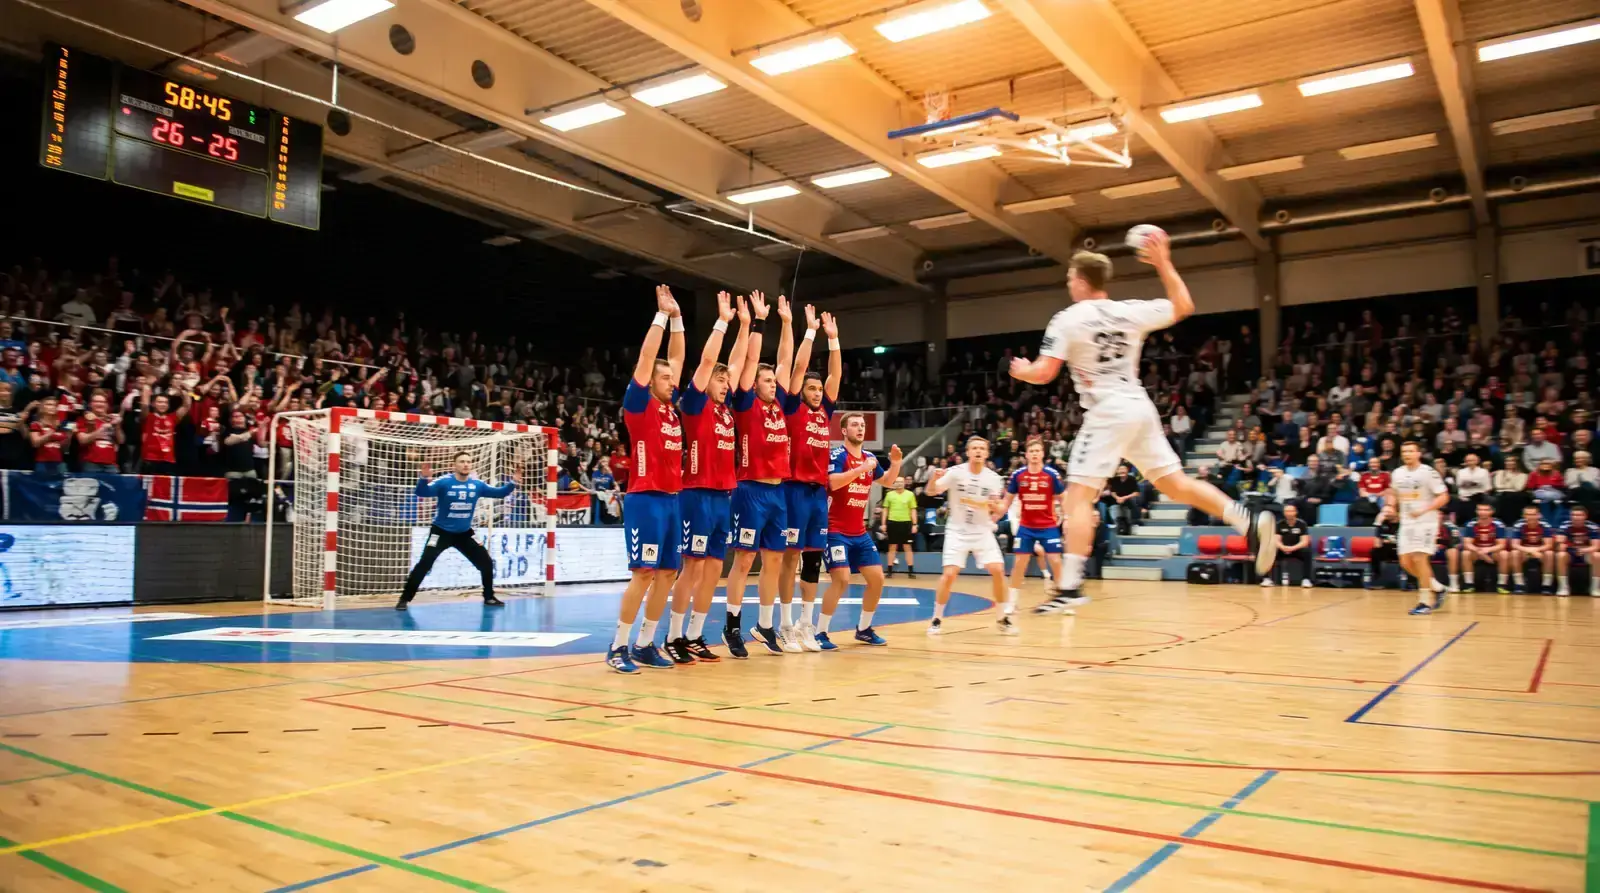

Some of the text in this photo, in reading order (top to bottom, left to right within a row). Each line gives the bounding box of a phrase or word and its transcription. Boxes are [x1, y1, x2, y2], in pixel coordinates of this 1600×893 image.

[164, 81, 232, 121] 58:45
[152, 117, 185, 147] 26
[208, 133, 240, 161] 25
